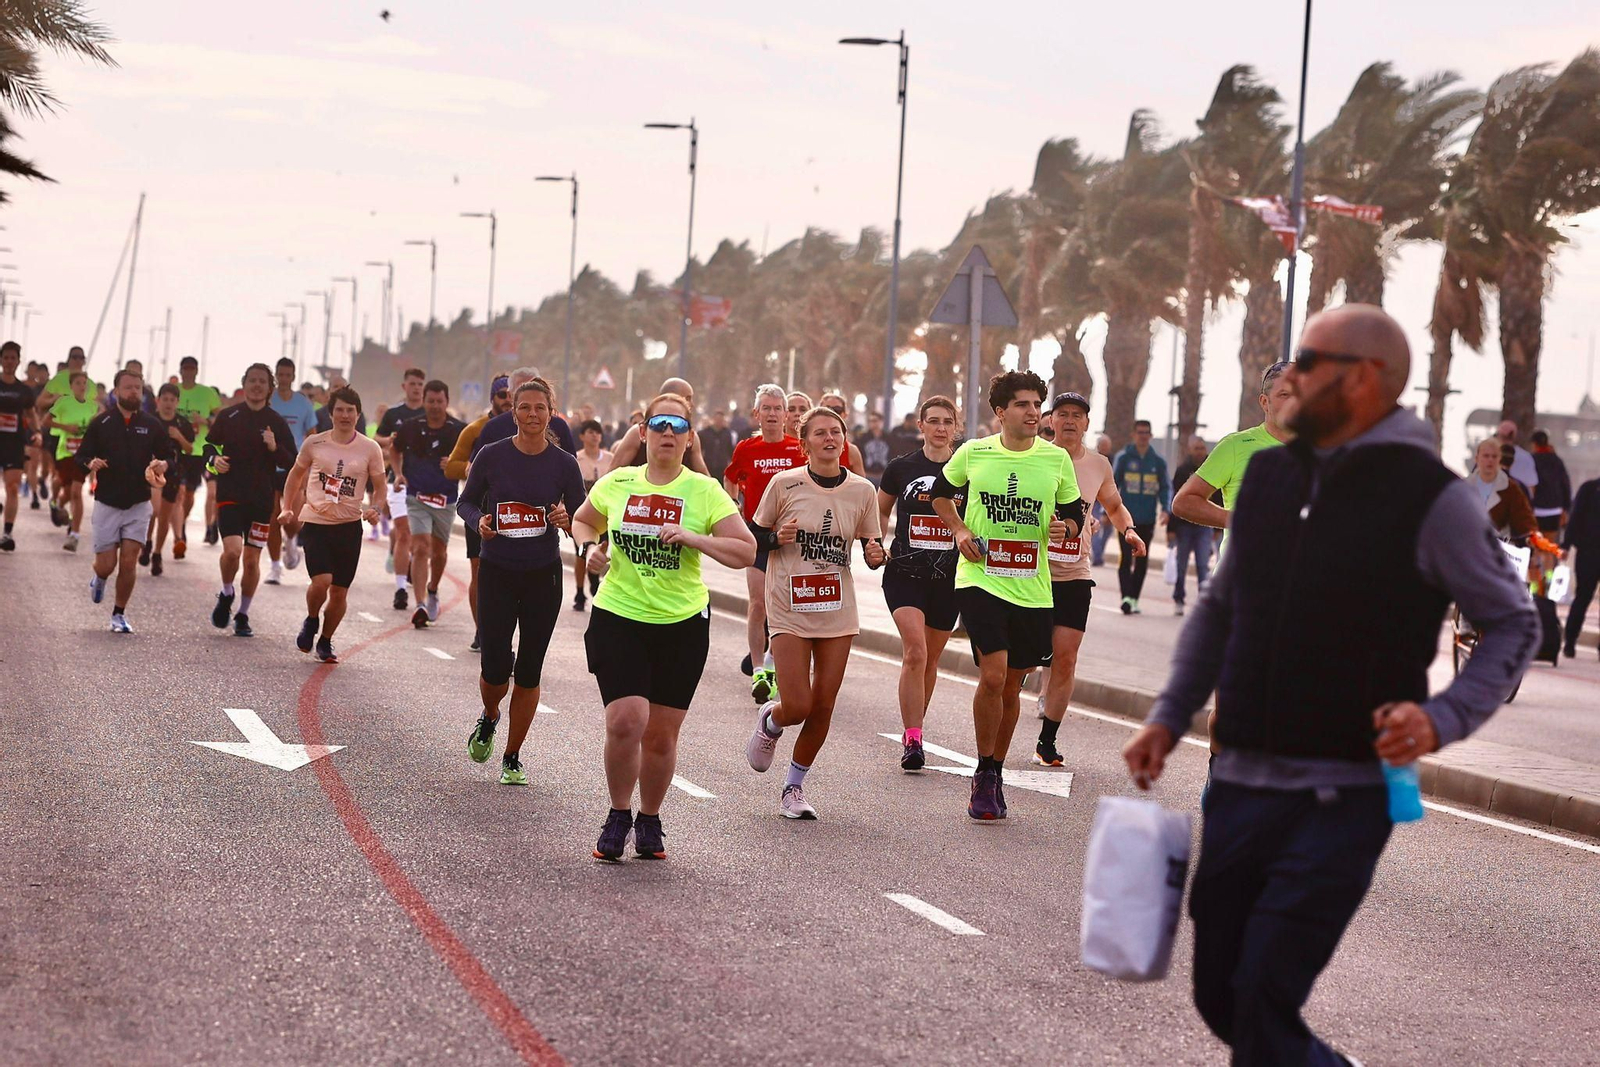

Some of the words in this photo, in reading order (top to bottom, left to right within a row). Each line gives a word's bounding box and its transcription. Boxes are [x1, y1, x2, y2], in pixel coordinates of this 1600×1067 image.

[754, 458, 792, 468] FORRES
[979, 491, 1043, 513] BRUNCH
[524, 514, 540, 522] 421
[653, 508, 676, 520] 412
[986, 505, 1017, 524] RUN
[931, 527, 952, 537] 1159
[611, 530, 682, 556] BRUNCH
[1064, 541, 1078, 550] 533
[800, 543, 828, 561] RUN
[1014, 553, 1033, 563] 650
[819, 586, 836, 596] 651
